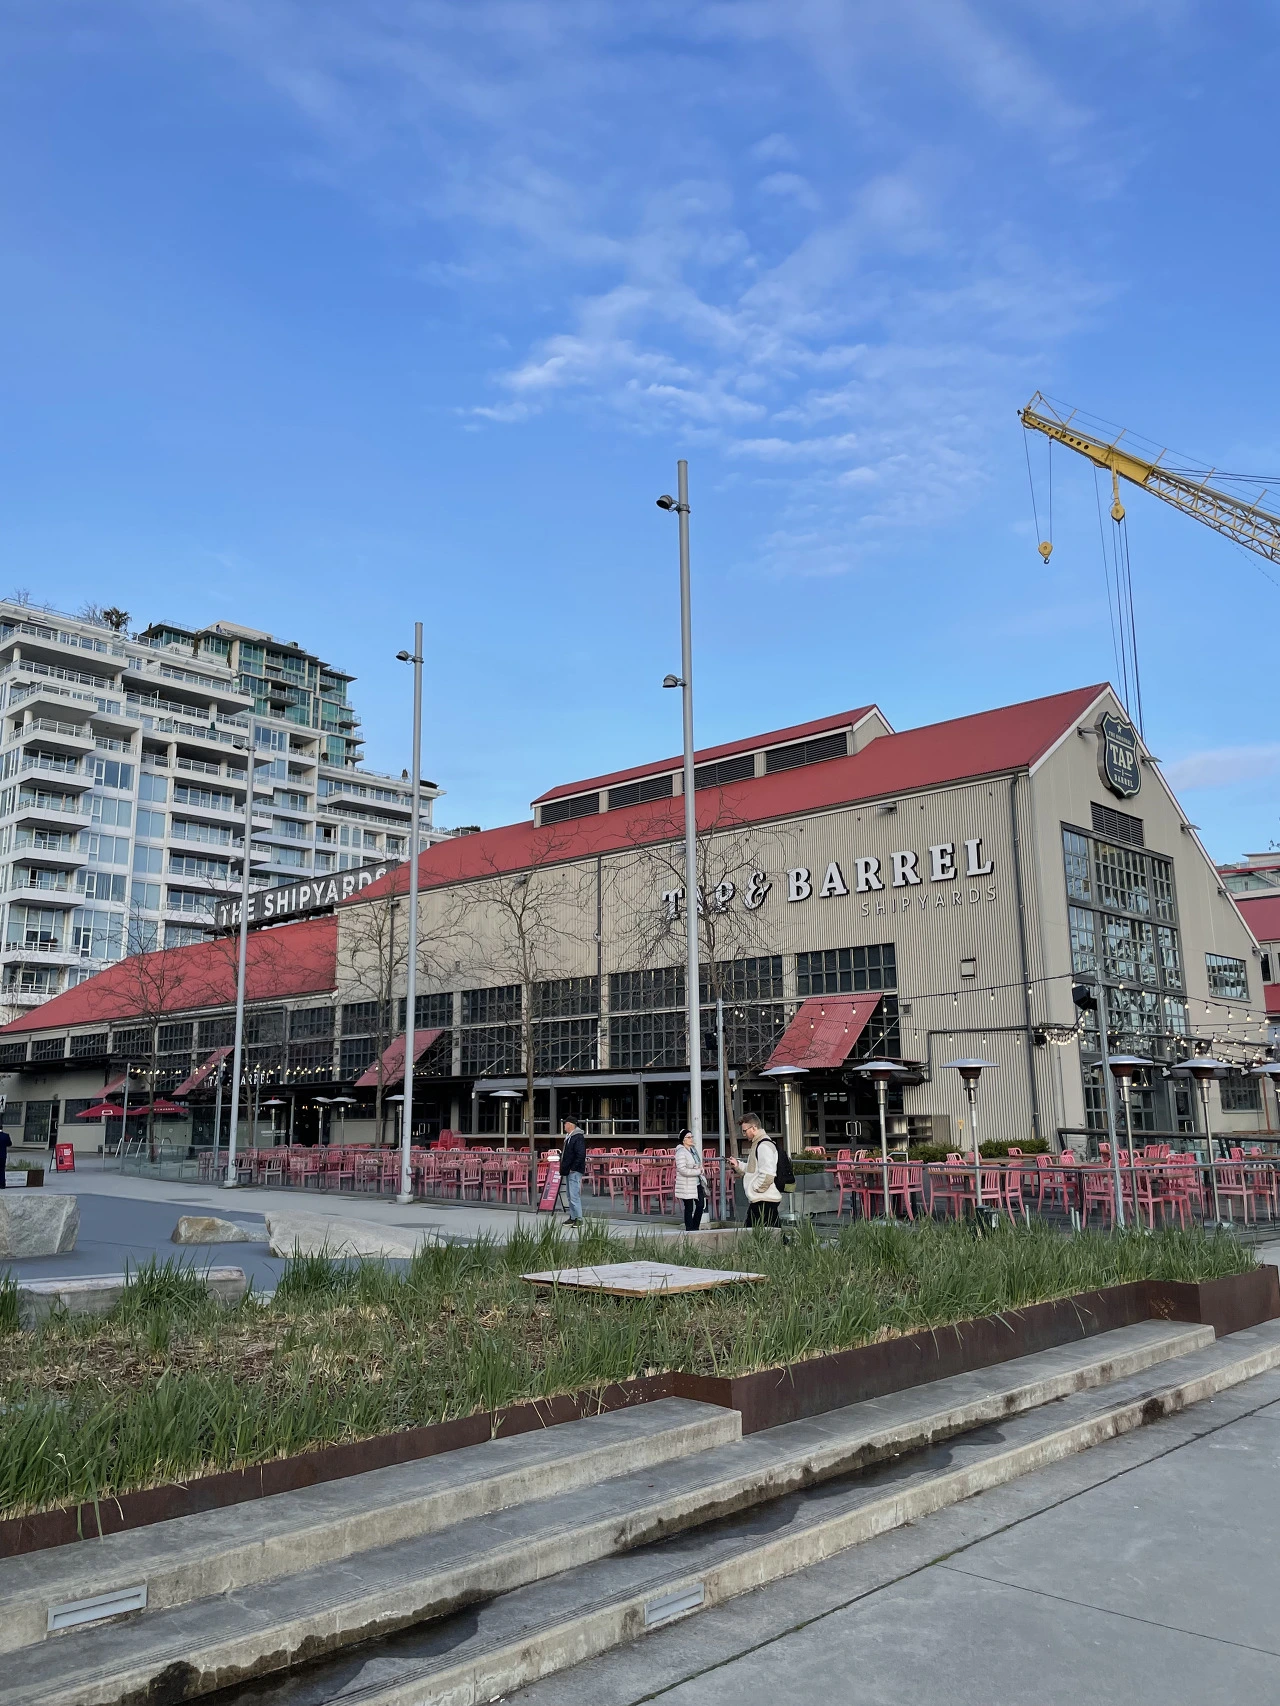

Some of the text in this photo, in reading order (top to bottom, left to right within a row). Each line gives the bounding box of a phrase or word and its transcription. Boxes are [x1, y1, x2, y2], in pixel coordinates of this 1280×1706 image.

[1110, 744, 1134, 771] TAP
[745, 870, 772, 910] &
[787, 838, 994, 903] BARREL
[220, 898, 255, 926] THE
[861, 886, 997, 917] SHIPYARDS
